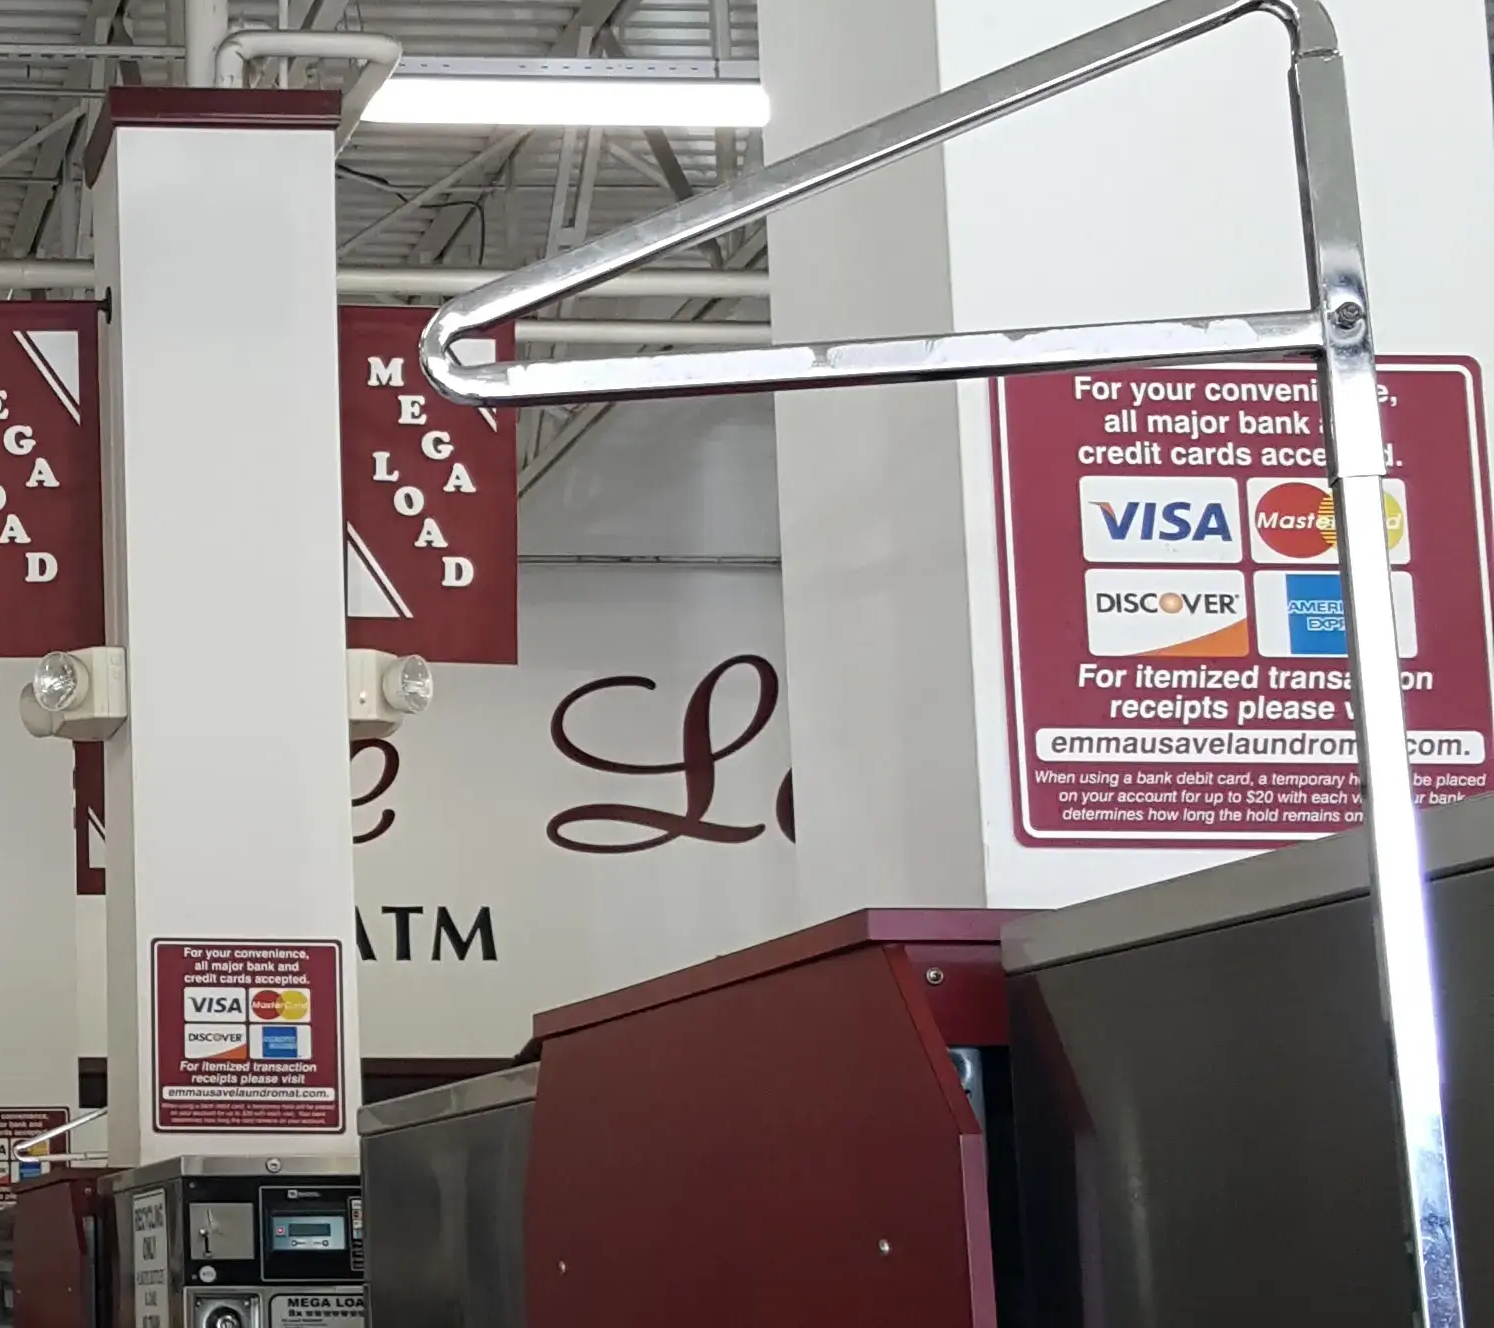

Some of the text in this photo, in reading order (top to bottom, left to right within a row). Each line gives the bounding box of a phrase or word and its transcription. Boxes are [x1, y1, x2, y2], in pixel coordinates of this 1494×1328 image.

[1074, 375, 1398, 407] For your convenie,
[367, 356, 476, 493] MEGA
[1104, 410, 1137, 434] all
[1147, 410, 1230, 439] major
[1238, 410, 1311, 435] bank
[1077, 441, 1403, 467] credit cards acced.
[372, 451, 474, 587] LOAD
[1088, 501, 1233, 542] VISA
[1256, 511, 1403, 530] Masted
[1096, 592, 1238, 614] DISCOVER
[1288, 600, 1344, 614] AMERI
[1078, 663, 1434, 691] For itemized transaon
[1110, 694, 1228, 725] receipts
[1237, 696, 1335, 725] please
[1050, 732, 1471, 756] emmausavelaundromcom.
[1035, 770, 1076, 786] When
[1080, 771, 1119, 789] using
[1123, 775, 1133, 786] a
[1137, 771, 1171, 786] bank
[1176, 771, 1213, 786] debit
[1217, 772, 1254, 788] card,
[1258, 776, 1268, 787] a
[1271, 773, 1345, 791] temporary
[1413, 773, 1432, 786] be
[1435, 773, 1487, 788] placed
[1058, 792, 1078, 803] on
[1081, 792, 1114, 807] your
[1118, 790, 1177, 804] account
[1181, 789, 1200, 803] for
[1204, 792, 1224, 807] up
[1227, 790, 1242, 803] to
[1245, 789, 1274, 804] $20
[1277, 789, 1307, 804] with
[1311, 789, 1347, 804] each
[1428, 791, 1466, 805] bank
[1062, 807, 1364, 824] determines how long the hold remains on
[183, 947, 310, 960] For your convenience,
[194, 960, 300, 973] all major bank and
[184, 973, 311, 986] credit cards accepted.
[189, 997, 242, 1013] VISA
[188, 1032, 244, 1043] DISCOVER
[180, 1060, 317, 1073] For itemized transaction
[191, 1073, 305, 1085] receipts please visit
[287, 1297, 364, 1308] MEGA LOA
